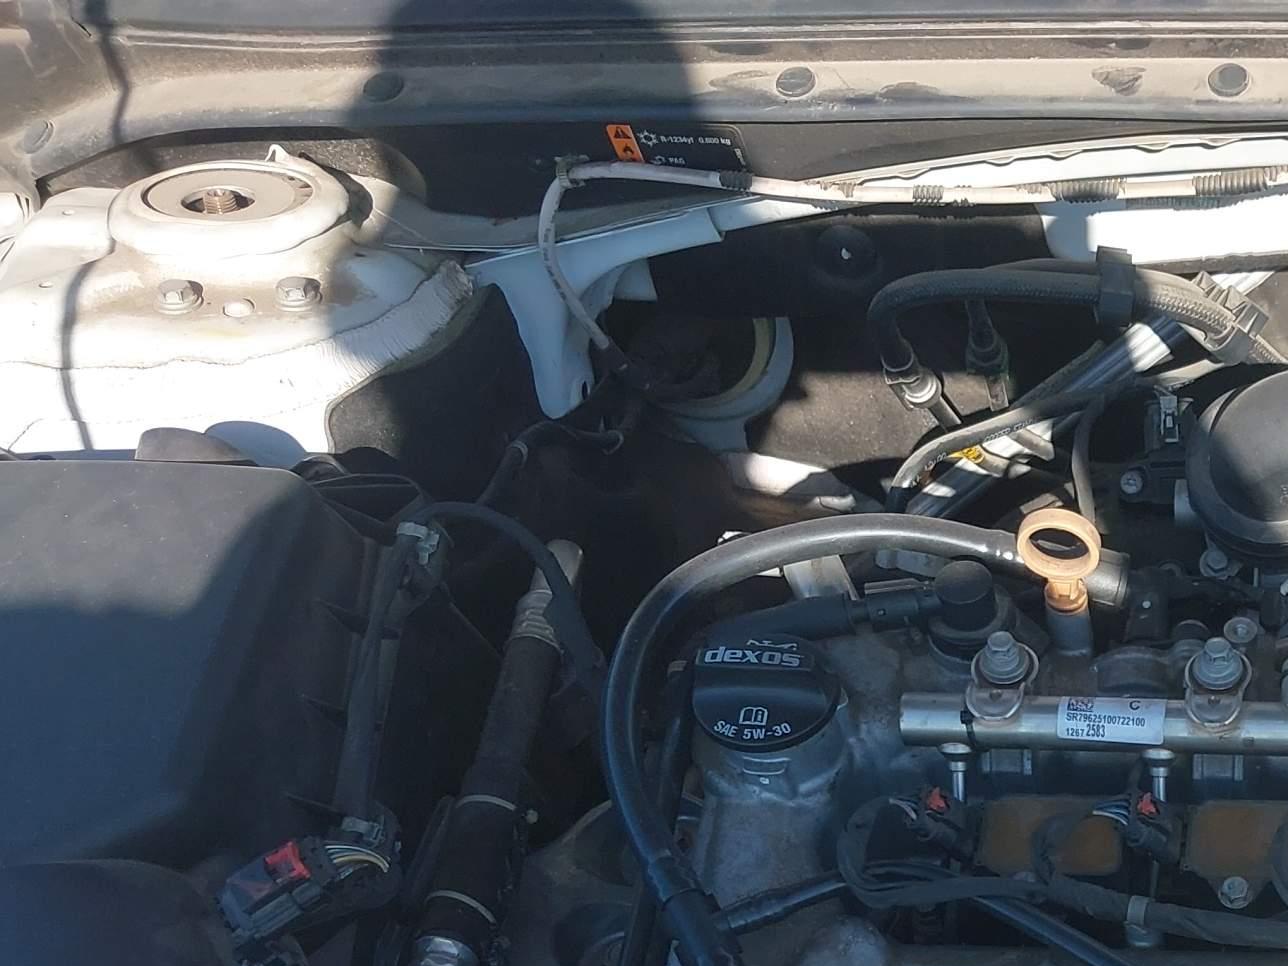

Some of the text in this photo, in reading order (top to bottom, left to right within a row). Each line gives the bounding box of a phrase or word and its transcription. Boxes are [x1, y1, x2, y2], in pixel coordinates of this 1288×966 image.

[704, 646, 805, 667] dexos
[1129, 700, 1141, 711] C
[1065, 712, 1146, 727] SR79625100722100
[713, 720, 792, 740] SAE 5W-30
[1086, 723, 1106, 738] 2583
